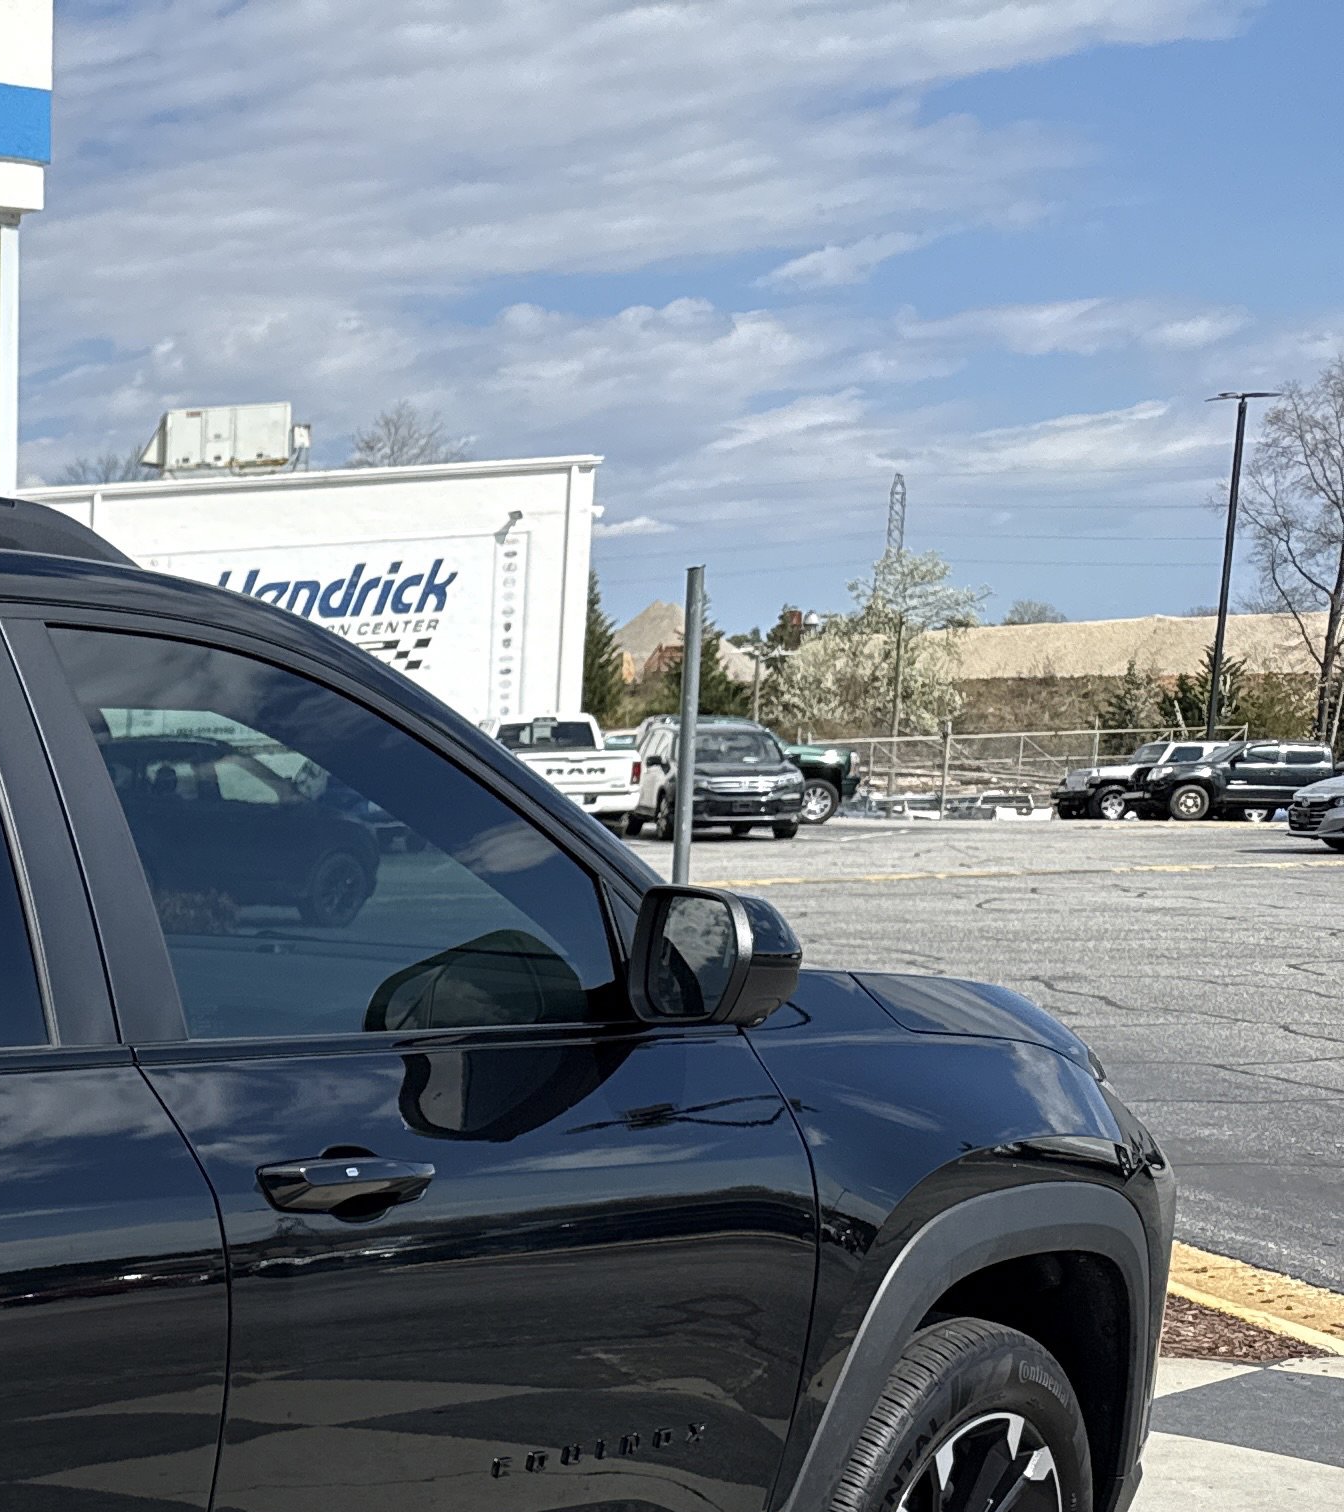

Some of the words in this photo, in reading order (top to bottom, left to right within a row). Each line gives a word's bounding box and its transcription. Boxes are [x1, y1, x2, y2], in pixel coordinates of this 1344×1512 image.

[357, 619, 440, 636] CENTER
[545, 766, 607, 776] RAM
[490, 1421, 708, 1479] EQUINOX
